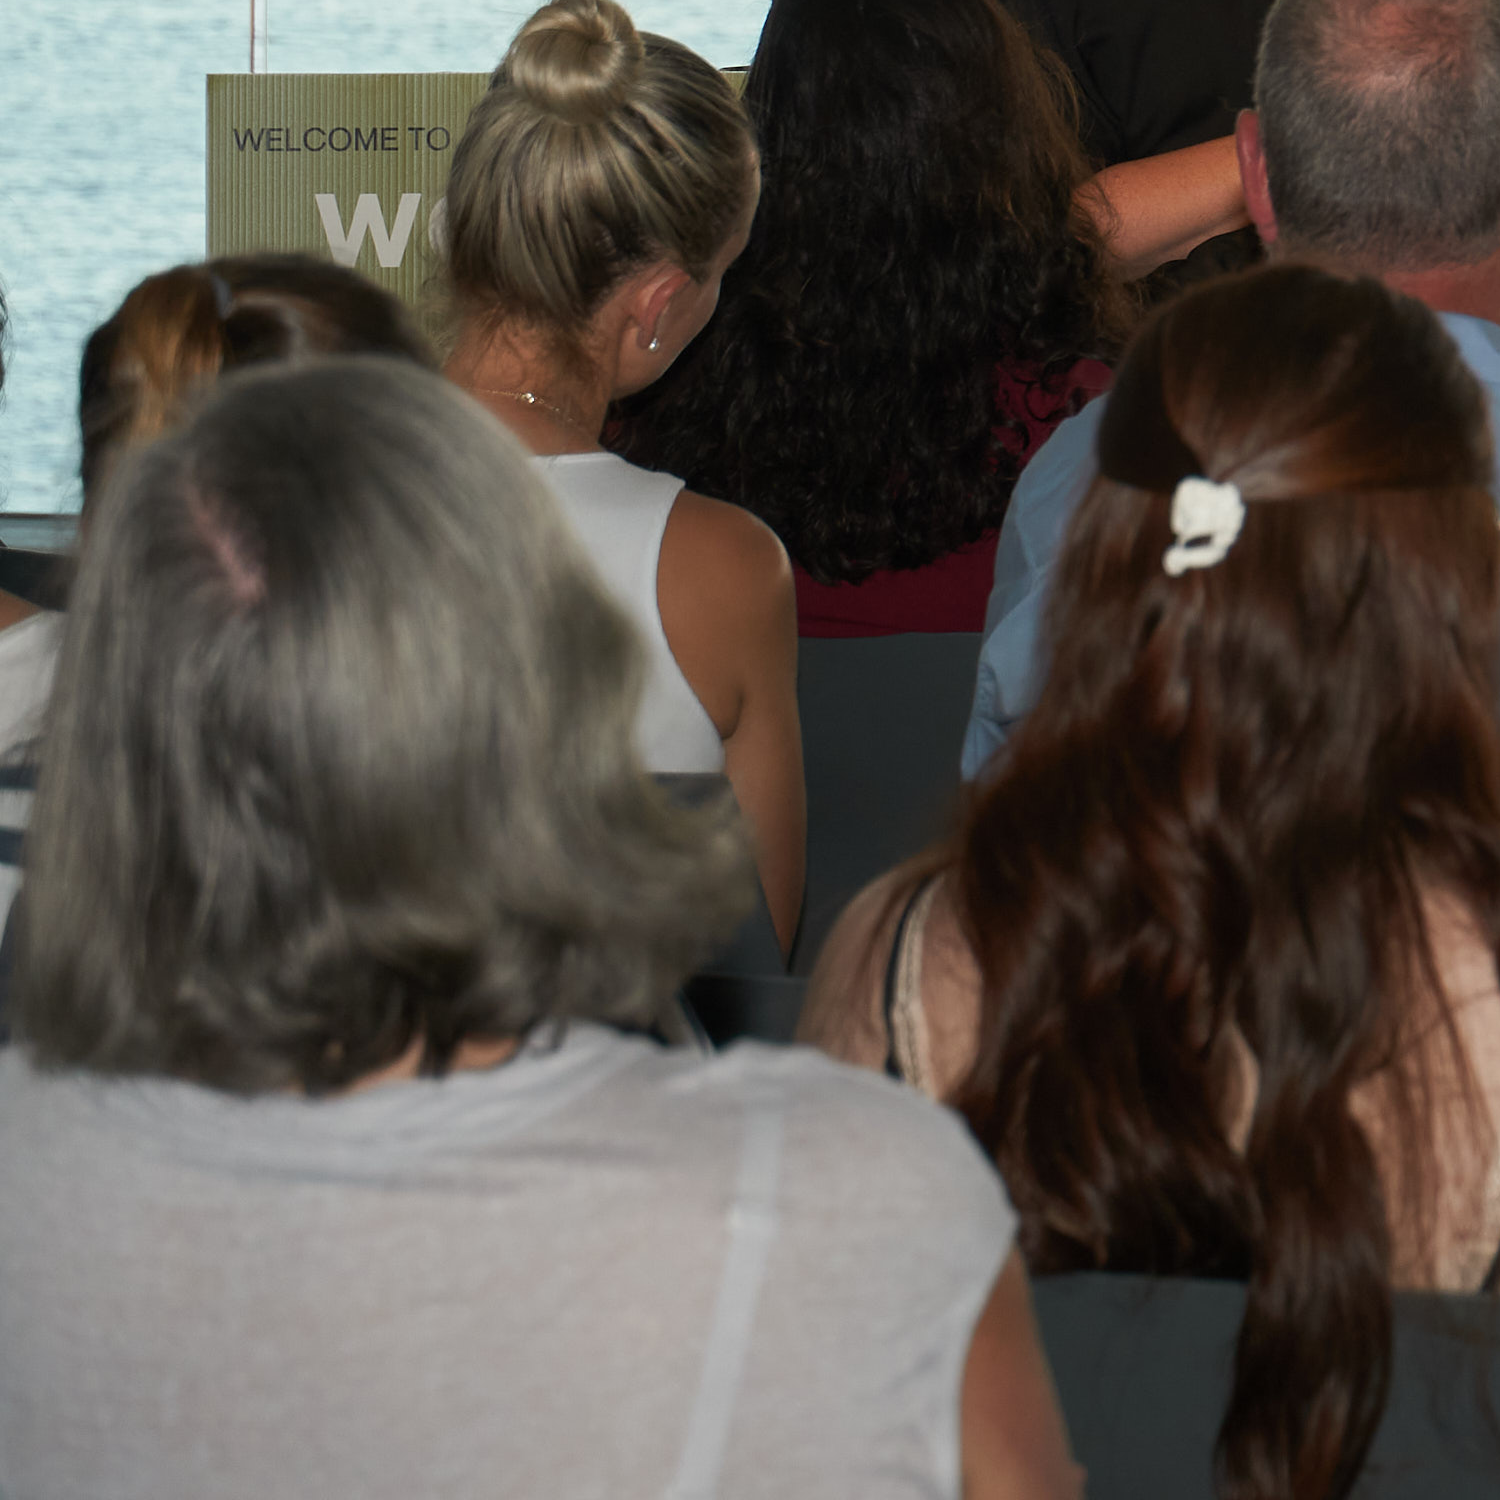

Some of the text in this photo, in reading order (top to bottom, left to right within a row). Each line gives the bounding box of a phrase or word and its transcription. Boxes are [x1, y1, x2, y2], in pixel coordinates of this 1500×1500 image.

[233, 126, 450, 152] WELCOME TO
[314, 193, 448, 268] W
